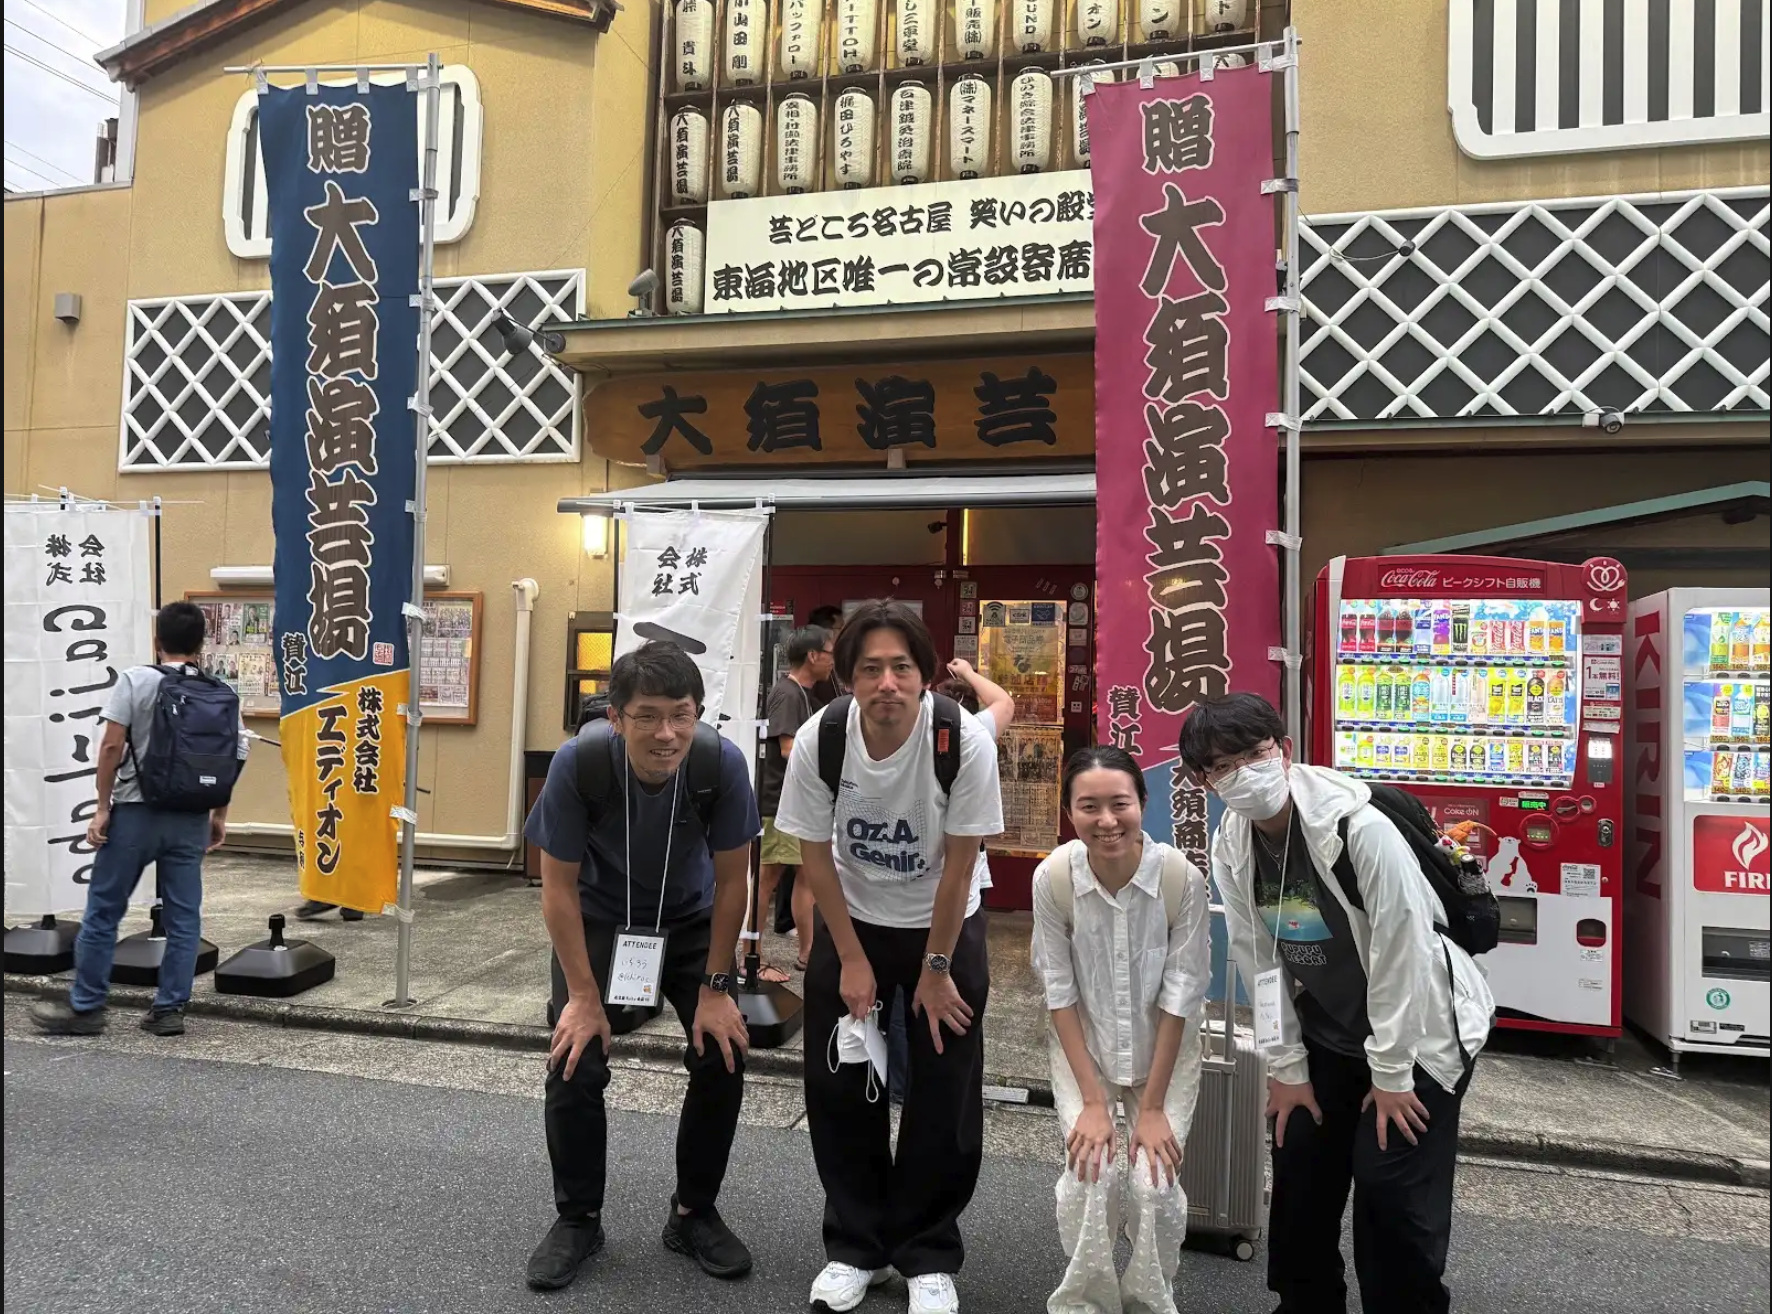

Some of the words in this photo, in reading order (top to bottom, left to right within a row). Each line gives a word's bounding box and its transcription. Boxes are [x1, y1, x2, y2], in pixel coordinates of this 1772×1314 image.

[306, 102, 372, 174] 贈
[1139, 92, 1215, 175] 贈
[768, 200, 953, 245] 芸どころ名古屋
[712, 239, 1093, 302] 東海地区唯一の常設寄席
[302, 180, 380, 661] 大須演芸場
[638, 365, 1058, 456] 大須演芸
[1139, 182, 1233, 715] 大須演芸場
[352, 685, 384, 795] 株式会社
[1635, 611, 1661, 900] KIRIN
[315, 704, 348, 875] エディオン
[1724, 871, 1770, 890] FIR
